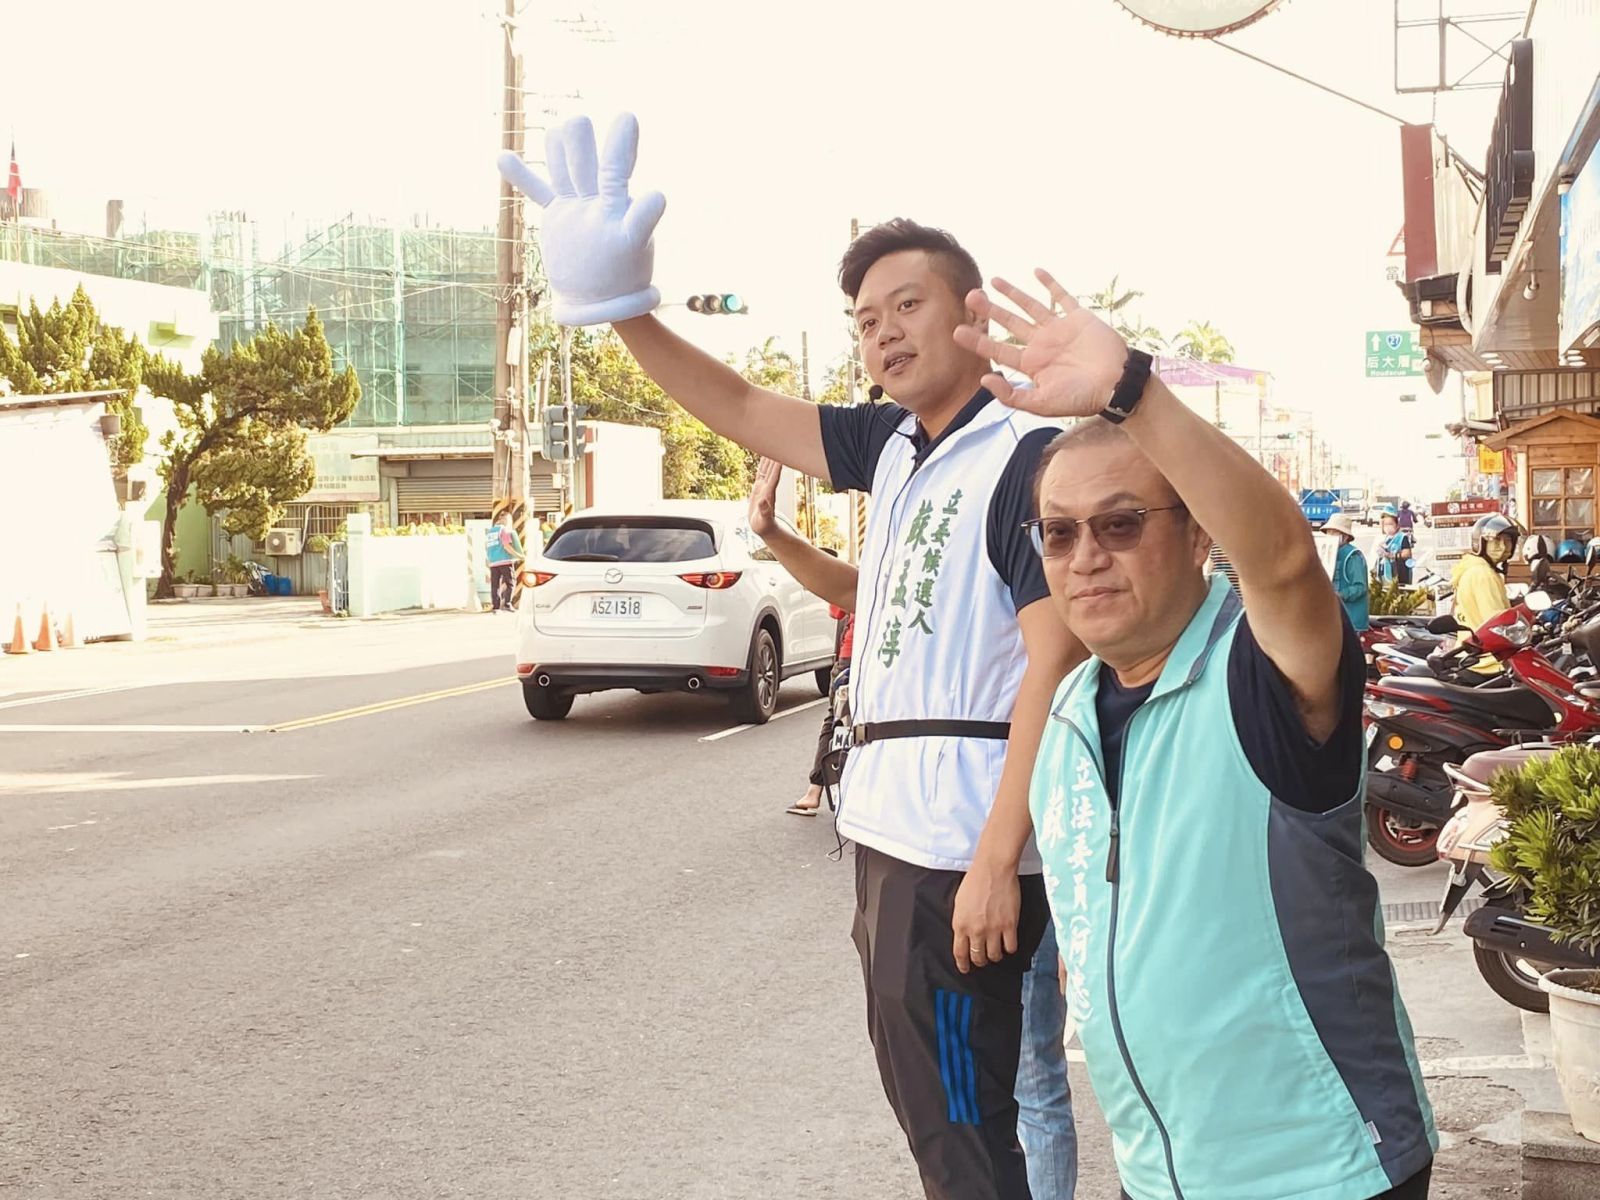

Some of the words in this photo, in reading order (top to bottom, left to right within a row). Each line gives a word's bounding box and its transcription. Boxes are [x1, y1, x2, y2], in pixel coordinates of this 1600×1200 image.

[908, 489, 963, 635] 立委候選人
